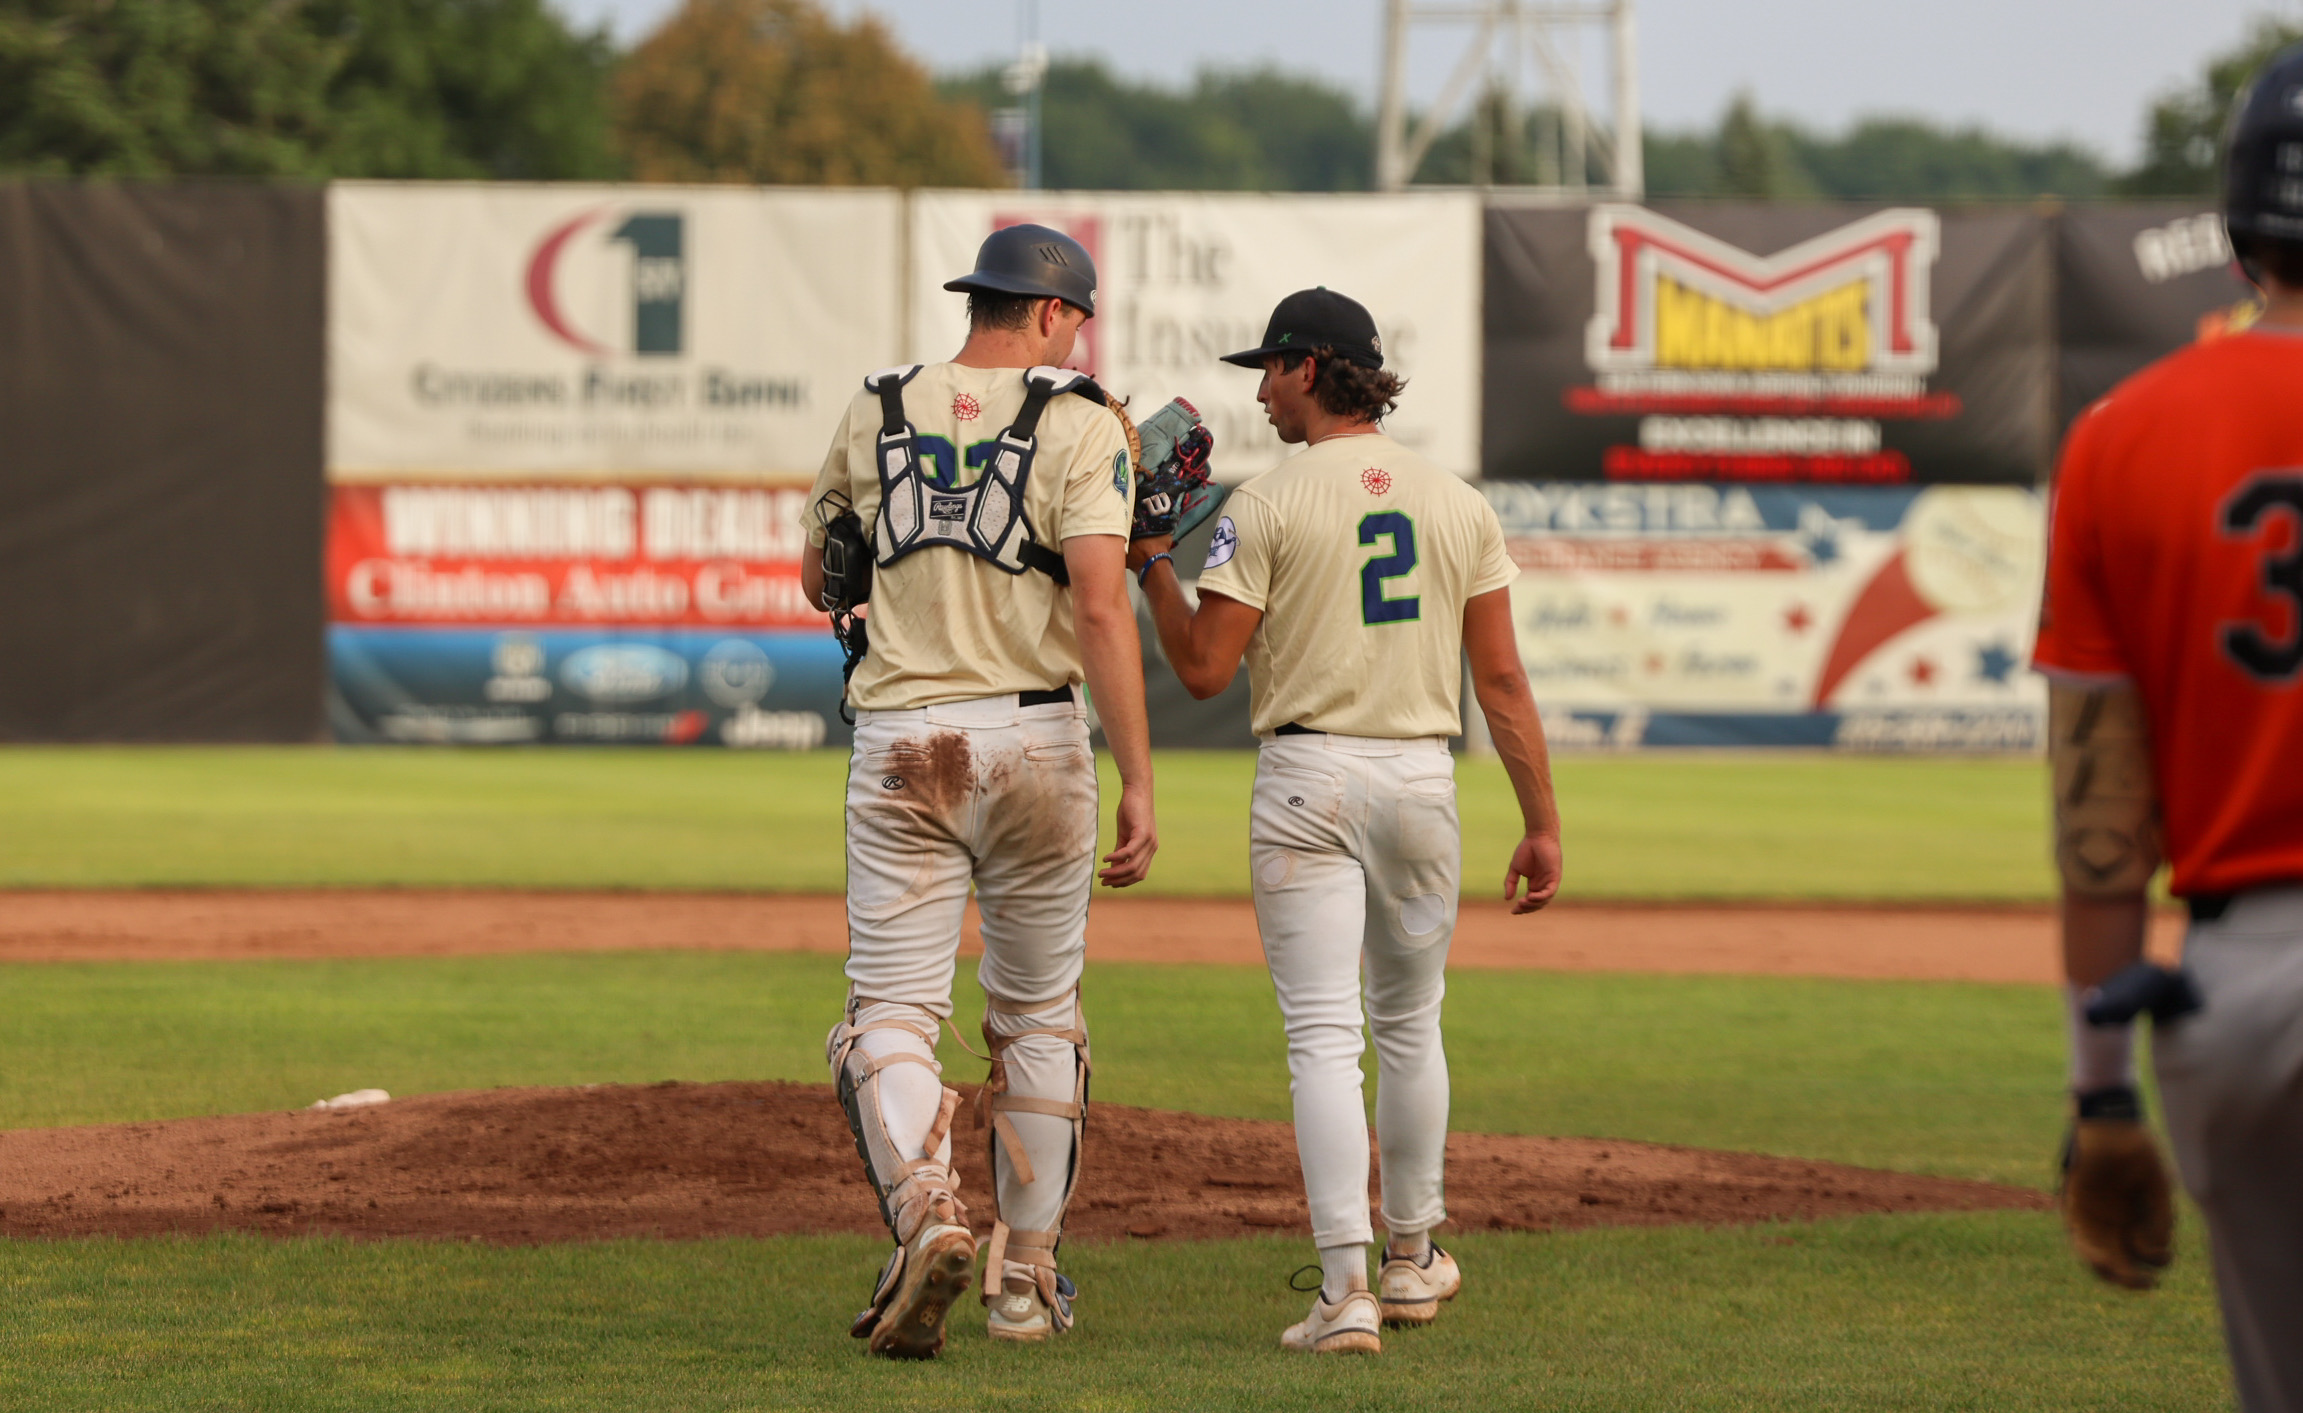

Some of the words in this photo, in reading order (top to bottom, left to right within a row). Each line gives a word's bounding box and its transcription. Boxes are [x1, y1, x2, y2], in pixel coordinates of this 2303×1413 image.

[1118, 210, 1231, 282] The
[382, 486, 638, 559] WINNING
[641, 488, 804, 562] DEALS
[1481, 482, 1767, 530] DYKSTRA
[347, 556, 550, 618] Clinton
[556, 562, 689, 618] Auto
[1357, 508, 1421, 627] 2
